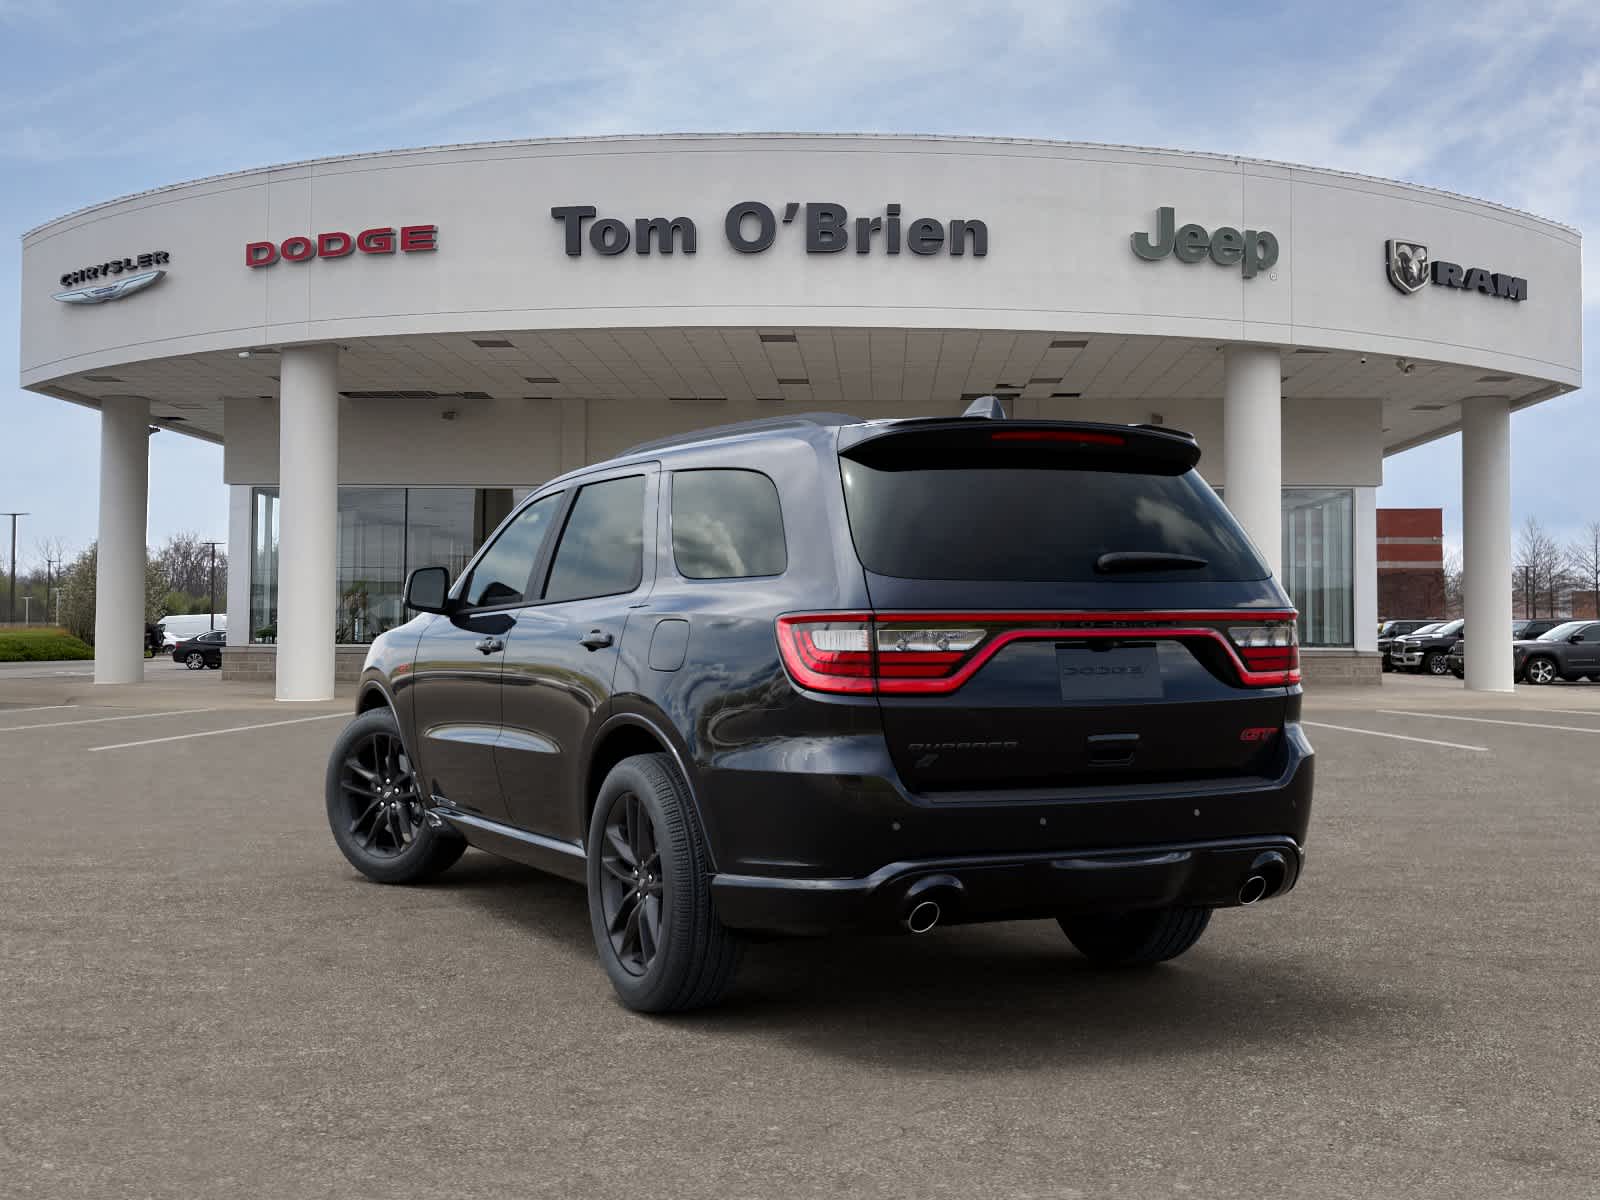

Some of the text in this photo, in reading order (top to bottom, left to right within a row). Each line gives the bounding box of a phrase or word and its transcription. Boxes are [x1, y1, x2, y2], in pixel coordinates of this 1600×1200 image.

[245, 225, 437, 269] DODGE
[551, 201, 988, 257] Tom O'Brien
[1131, 207, 1279, 279] Jeep
[60, 250, 170, 287] CHRYSLER
[1430, 260, 1528, 302] RAM
